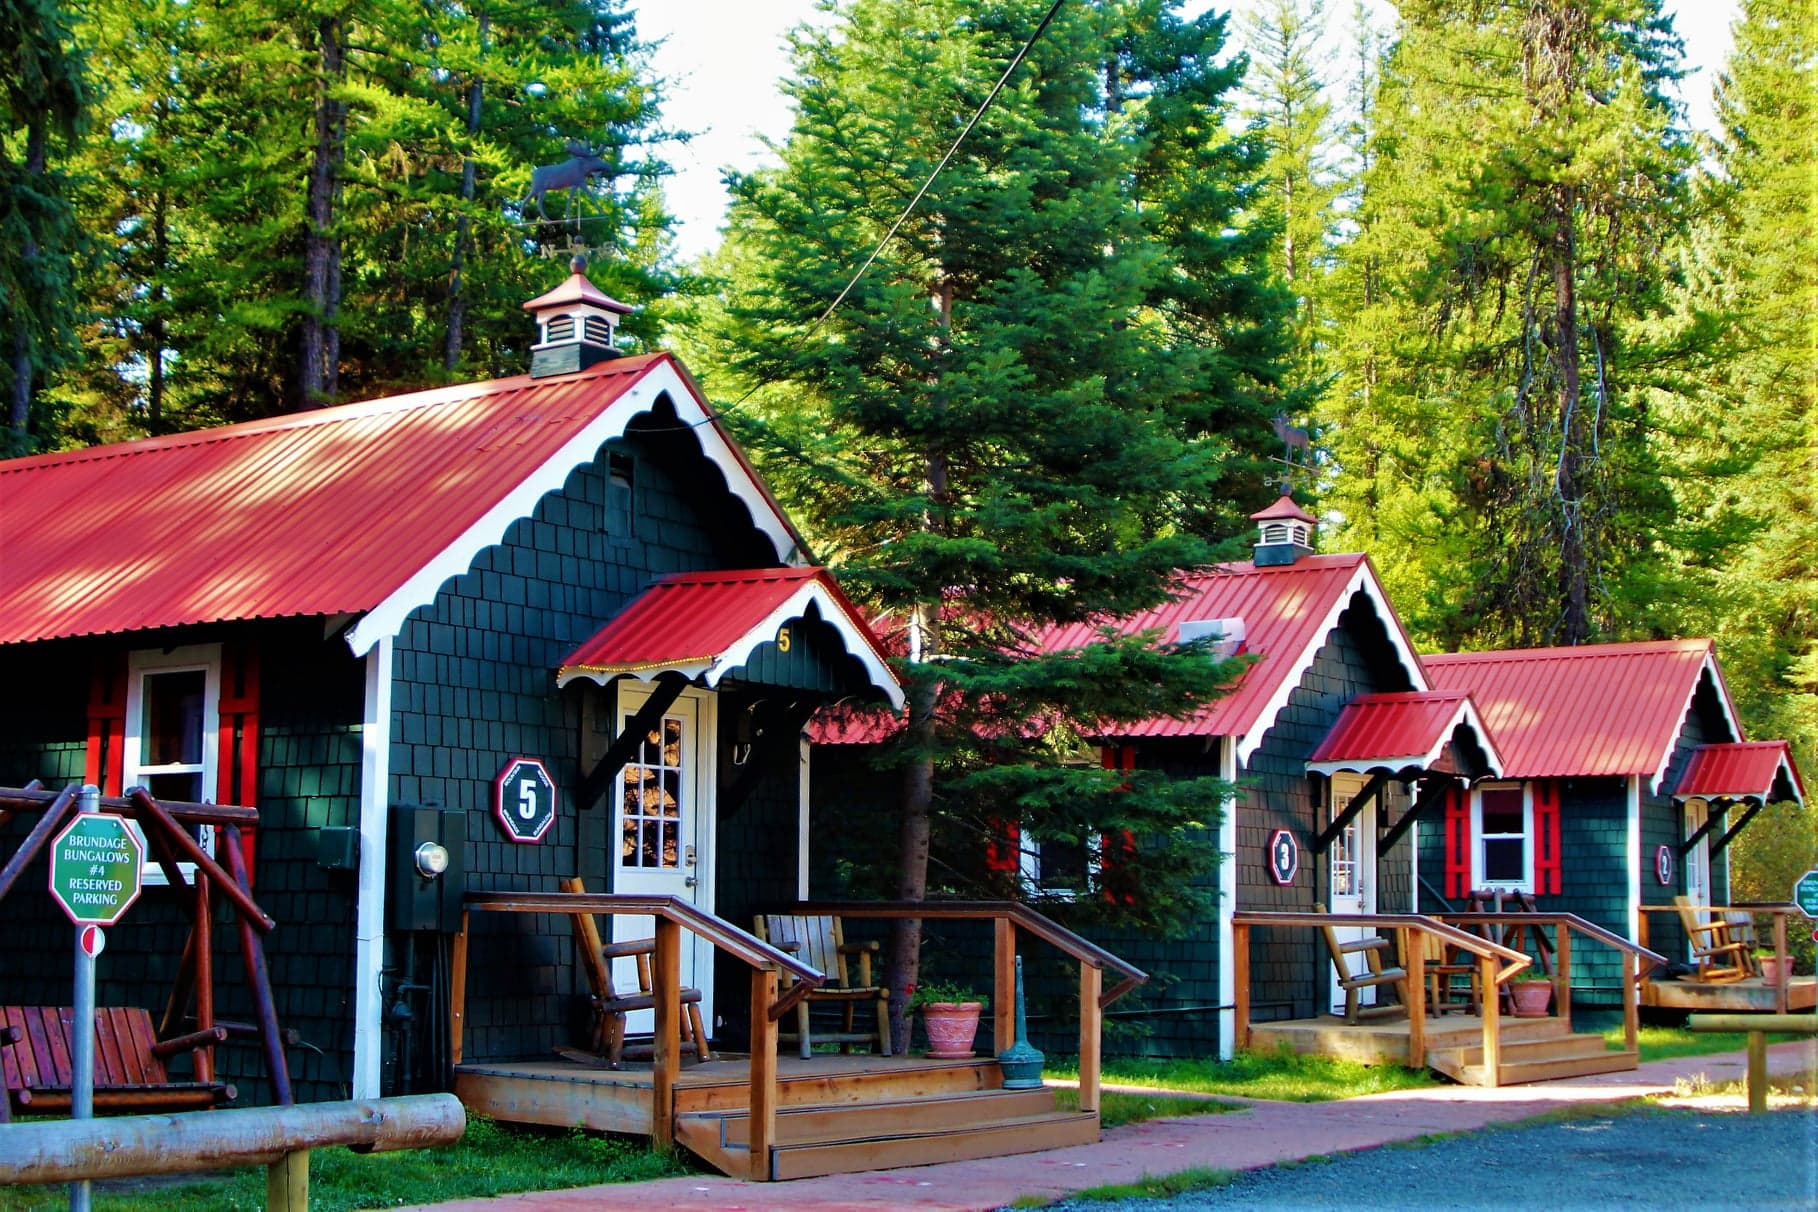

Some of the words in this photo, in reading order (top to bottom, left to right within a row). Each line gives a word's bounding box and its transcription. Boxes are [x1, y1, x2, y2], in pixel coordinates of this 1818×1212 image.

[779, 628, 790, 652] 5
[519, 779, 537, 820] 5
[69, 835, 127, 849] BRUNDAGE
[64, 849, 130, 863] BUNGALOWS
[1281, 843, 1290, 870] 3
[89, 864, 105, 877] #4
[1662, 855, 1668, 874] 2
[69, 878, 123, 891] RESERVED
[73, 892, 118, 905] PARKING
